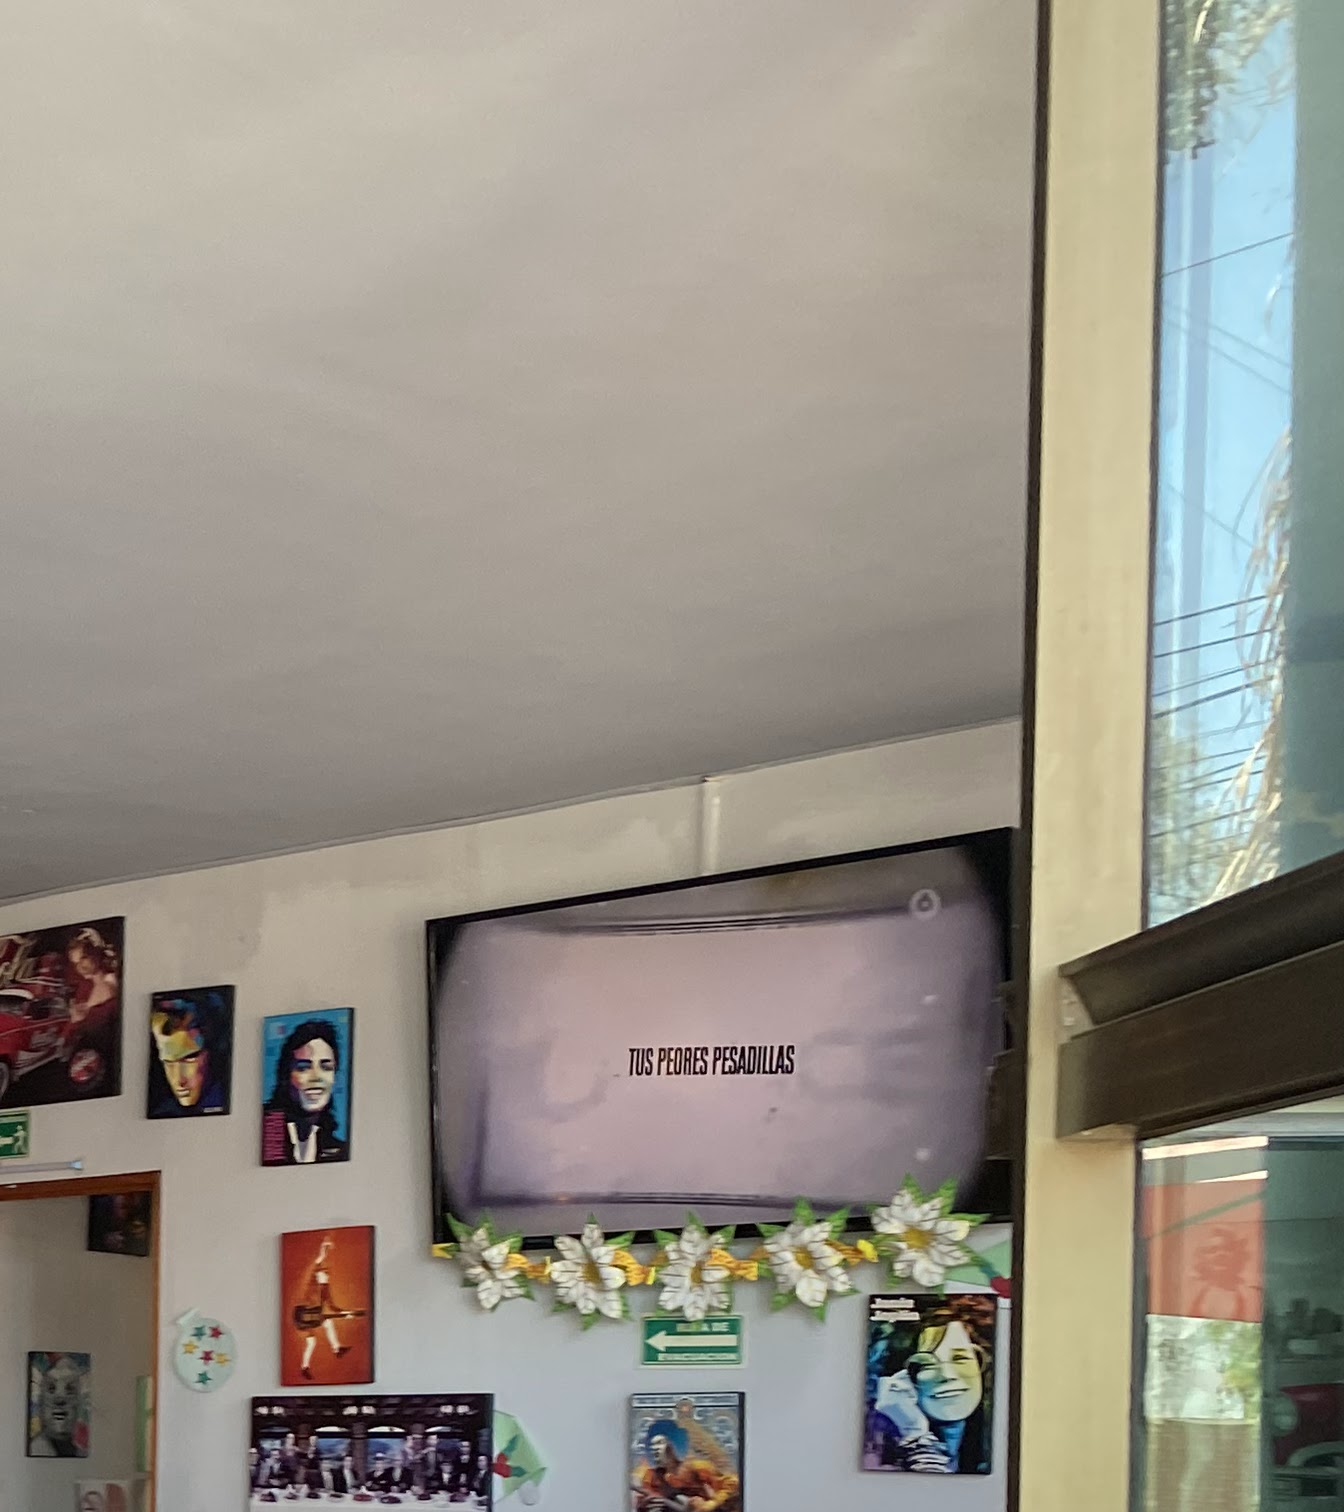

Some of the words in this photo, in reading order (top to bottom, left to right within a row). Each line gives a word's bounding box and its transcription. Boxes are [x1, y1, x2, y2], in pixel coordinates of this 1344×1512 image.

[628, 1047, 654, 1077] TUS
[656, 1046, 709, 1076] PEORES
[712, 1045, 795, 1076] PESADILLAS
